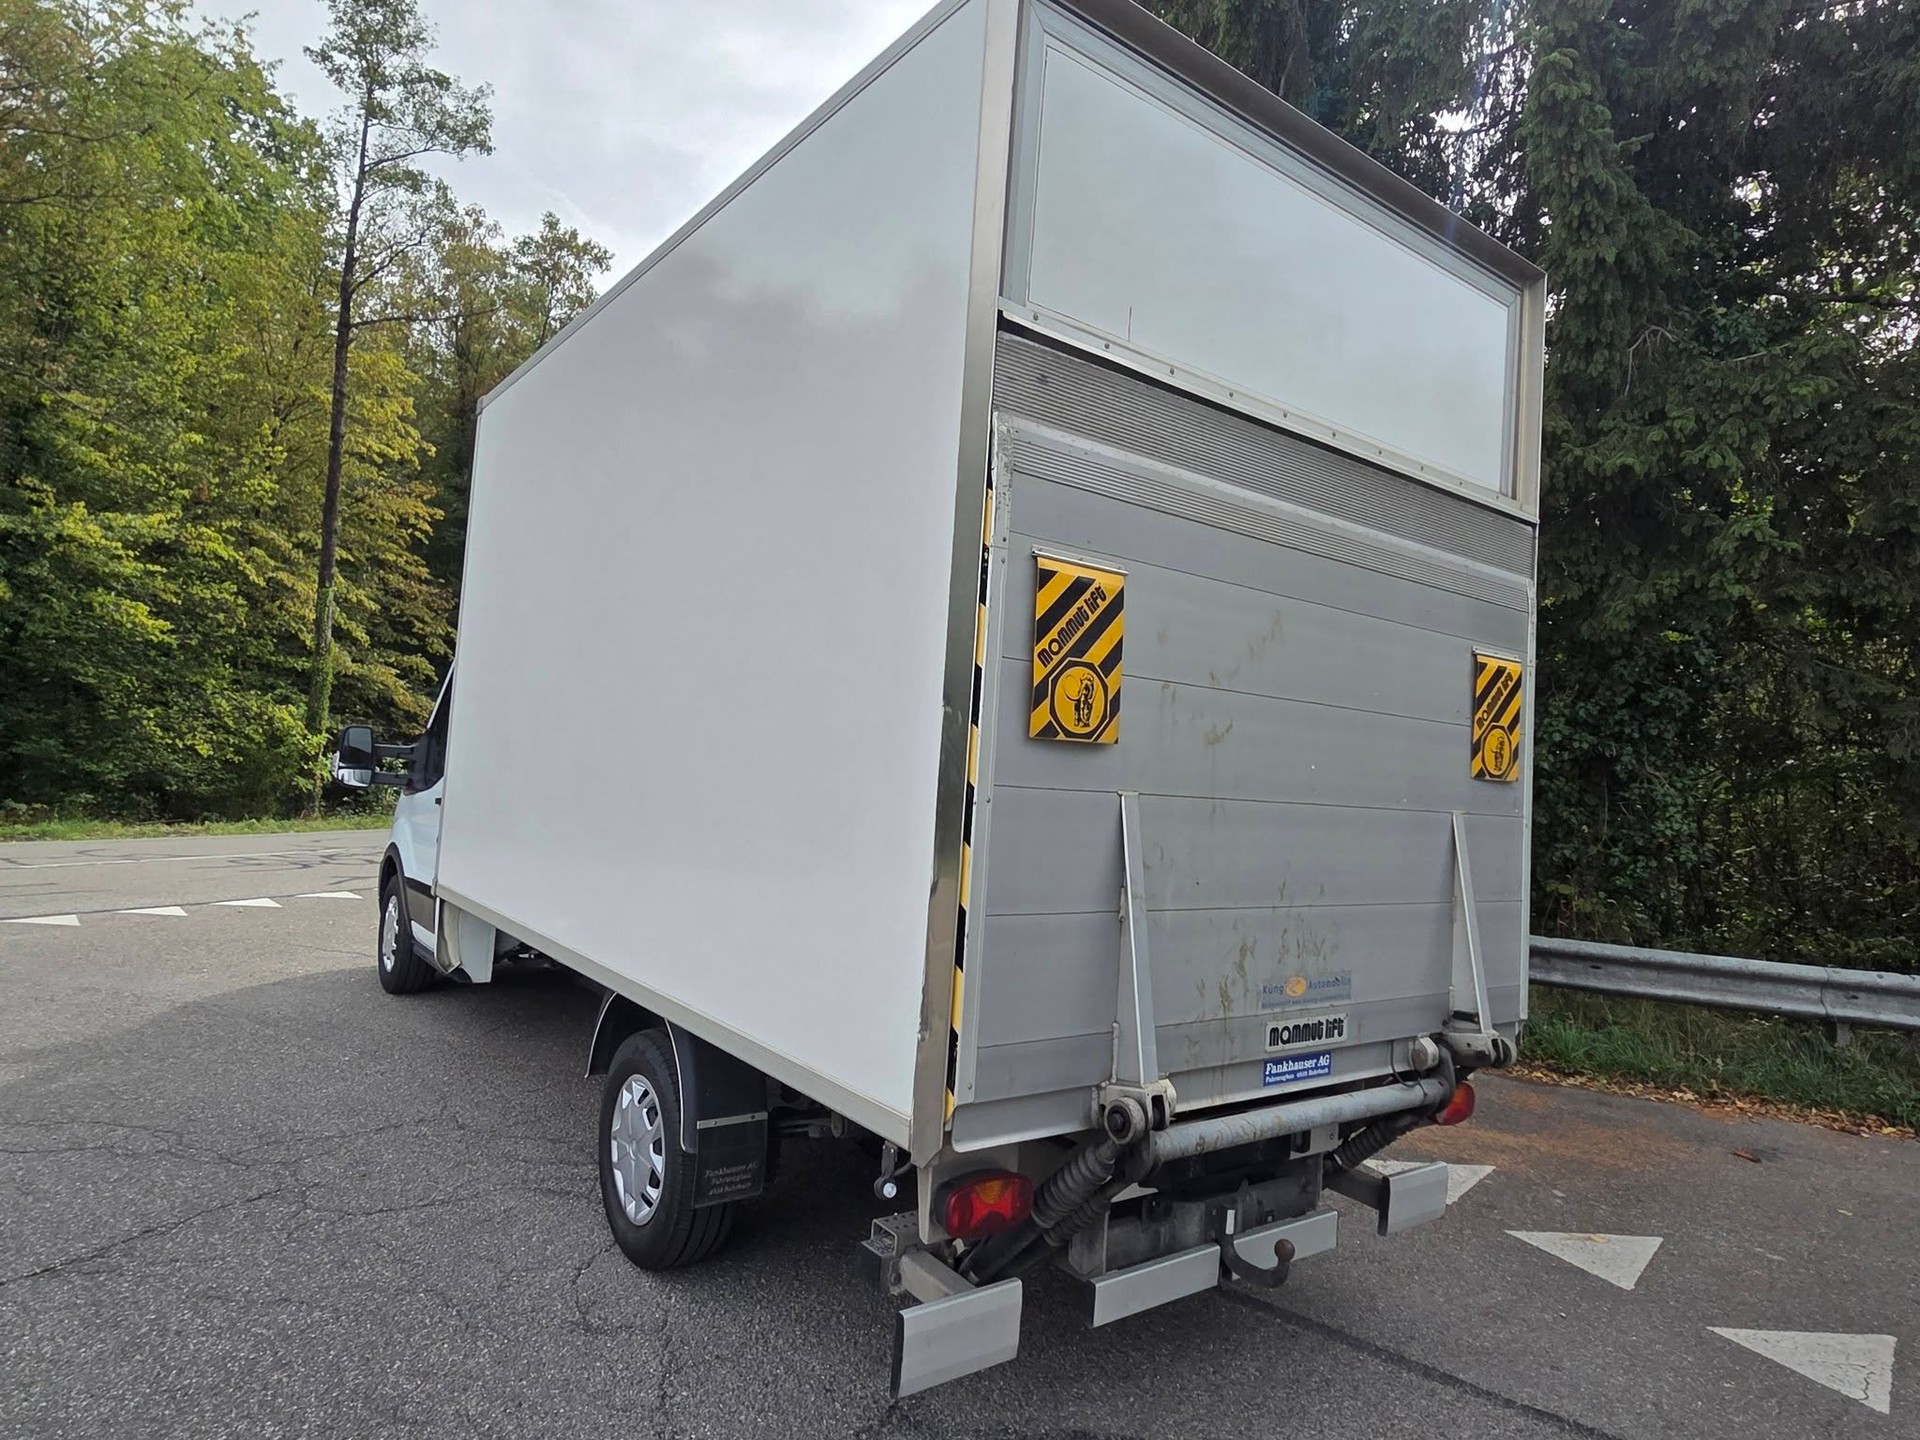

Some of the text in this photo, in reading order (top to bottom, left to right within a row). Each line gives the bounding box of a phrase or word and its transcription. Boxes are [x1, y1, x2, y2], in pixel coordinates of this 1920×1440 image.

[1037, 584, 1108, 669] mammut lift
[1269, 1017, 1345, 1047] mammut lift
[1265, 1054, 1330, 1075] Fankhauser AG
